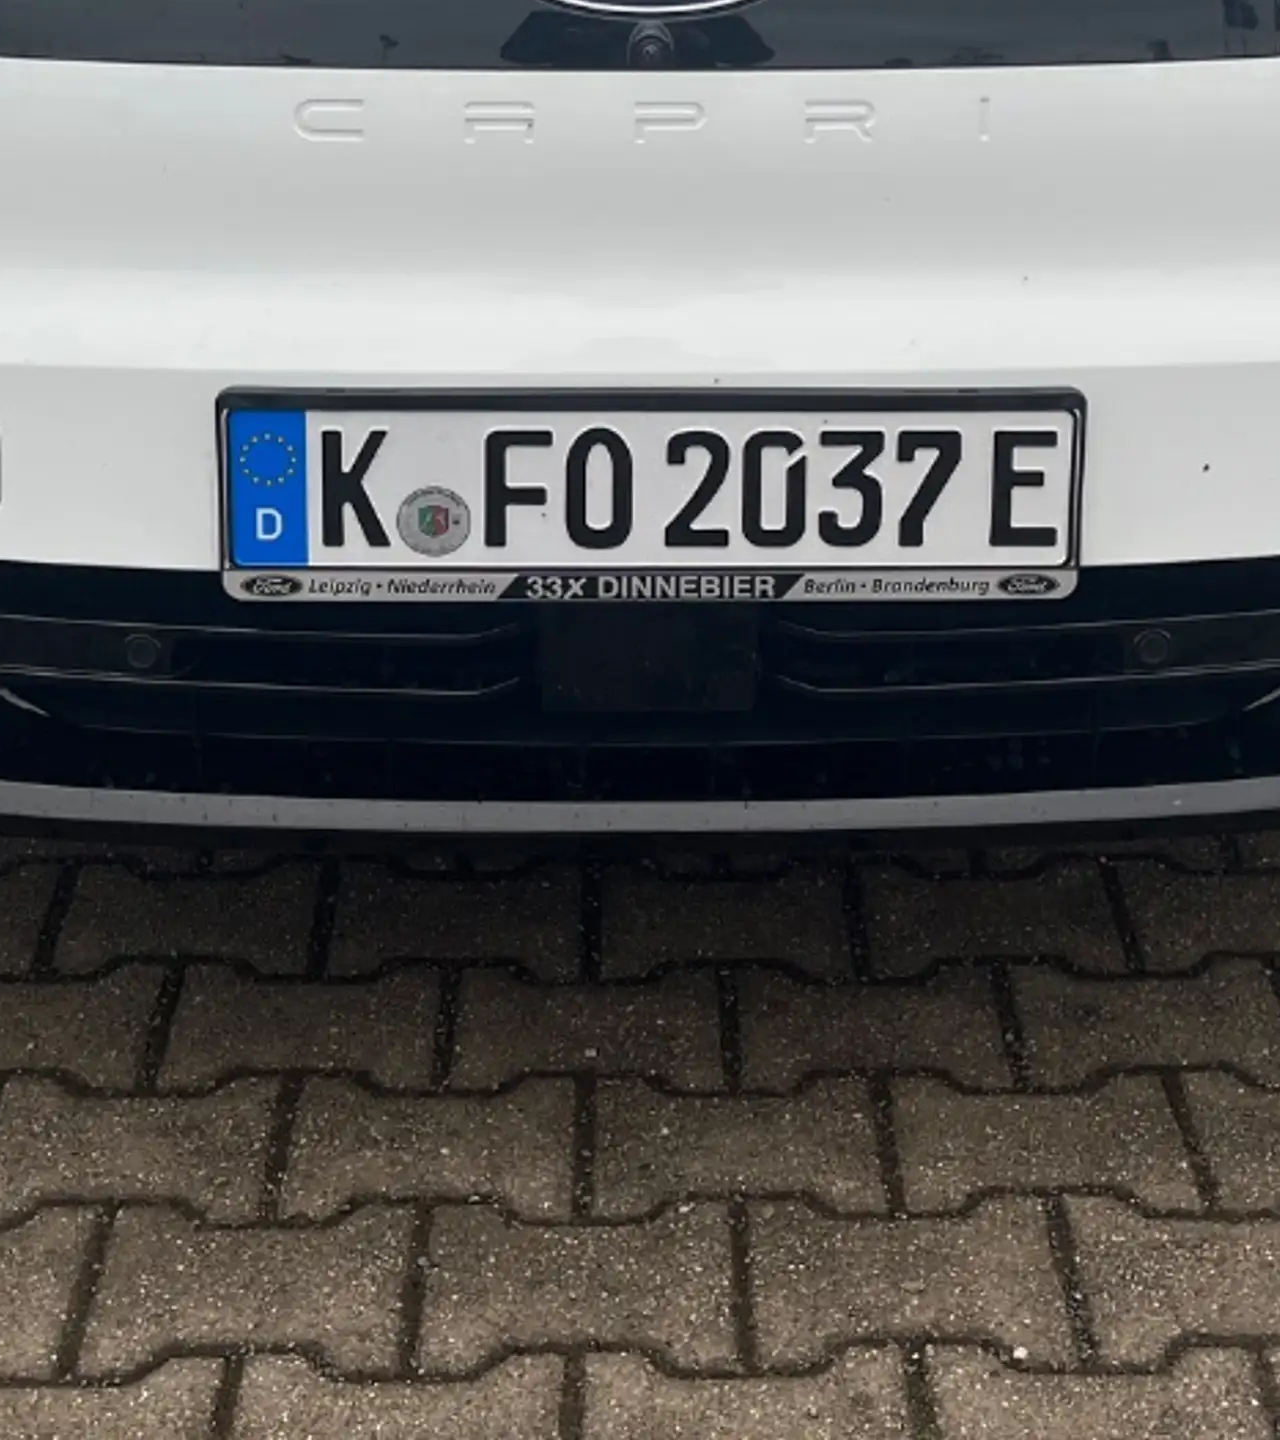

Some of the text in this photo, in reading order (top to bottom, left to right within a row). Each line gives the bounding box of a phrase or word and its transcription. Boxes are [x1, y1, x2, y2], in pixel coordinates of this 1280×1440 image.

[292, 96, 992, 144] CAPRI
[320, 430, 394, 548] K
[256, 507, 283, 540] D
[308, 577, 372, 597] Leipzig
[386, 576, 496, 595] Niederrhein
[597, 575, 776, 599] DINNEBIER
[803, 577, 857, 595] Berlin
[871, 575, 991, 596] Brandenburg
